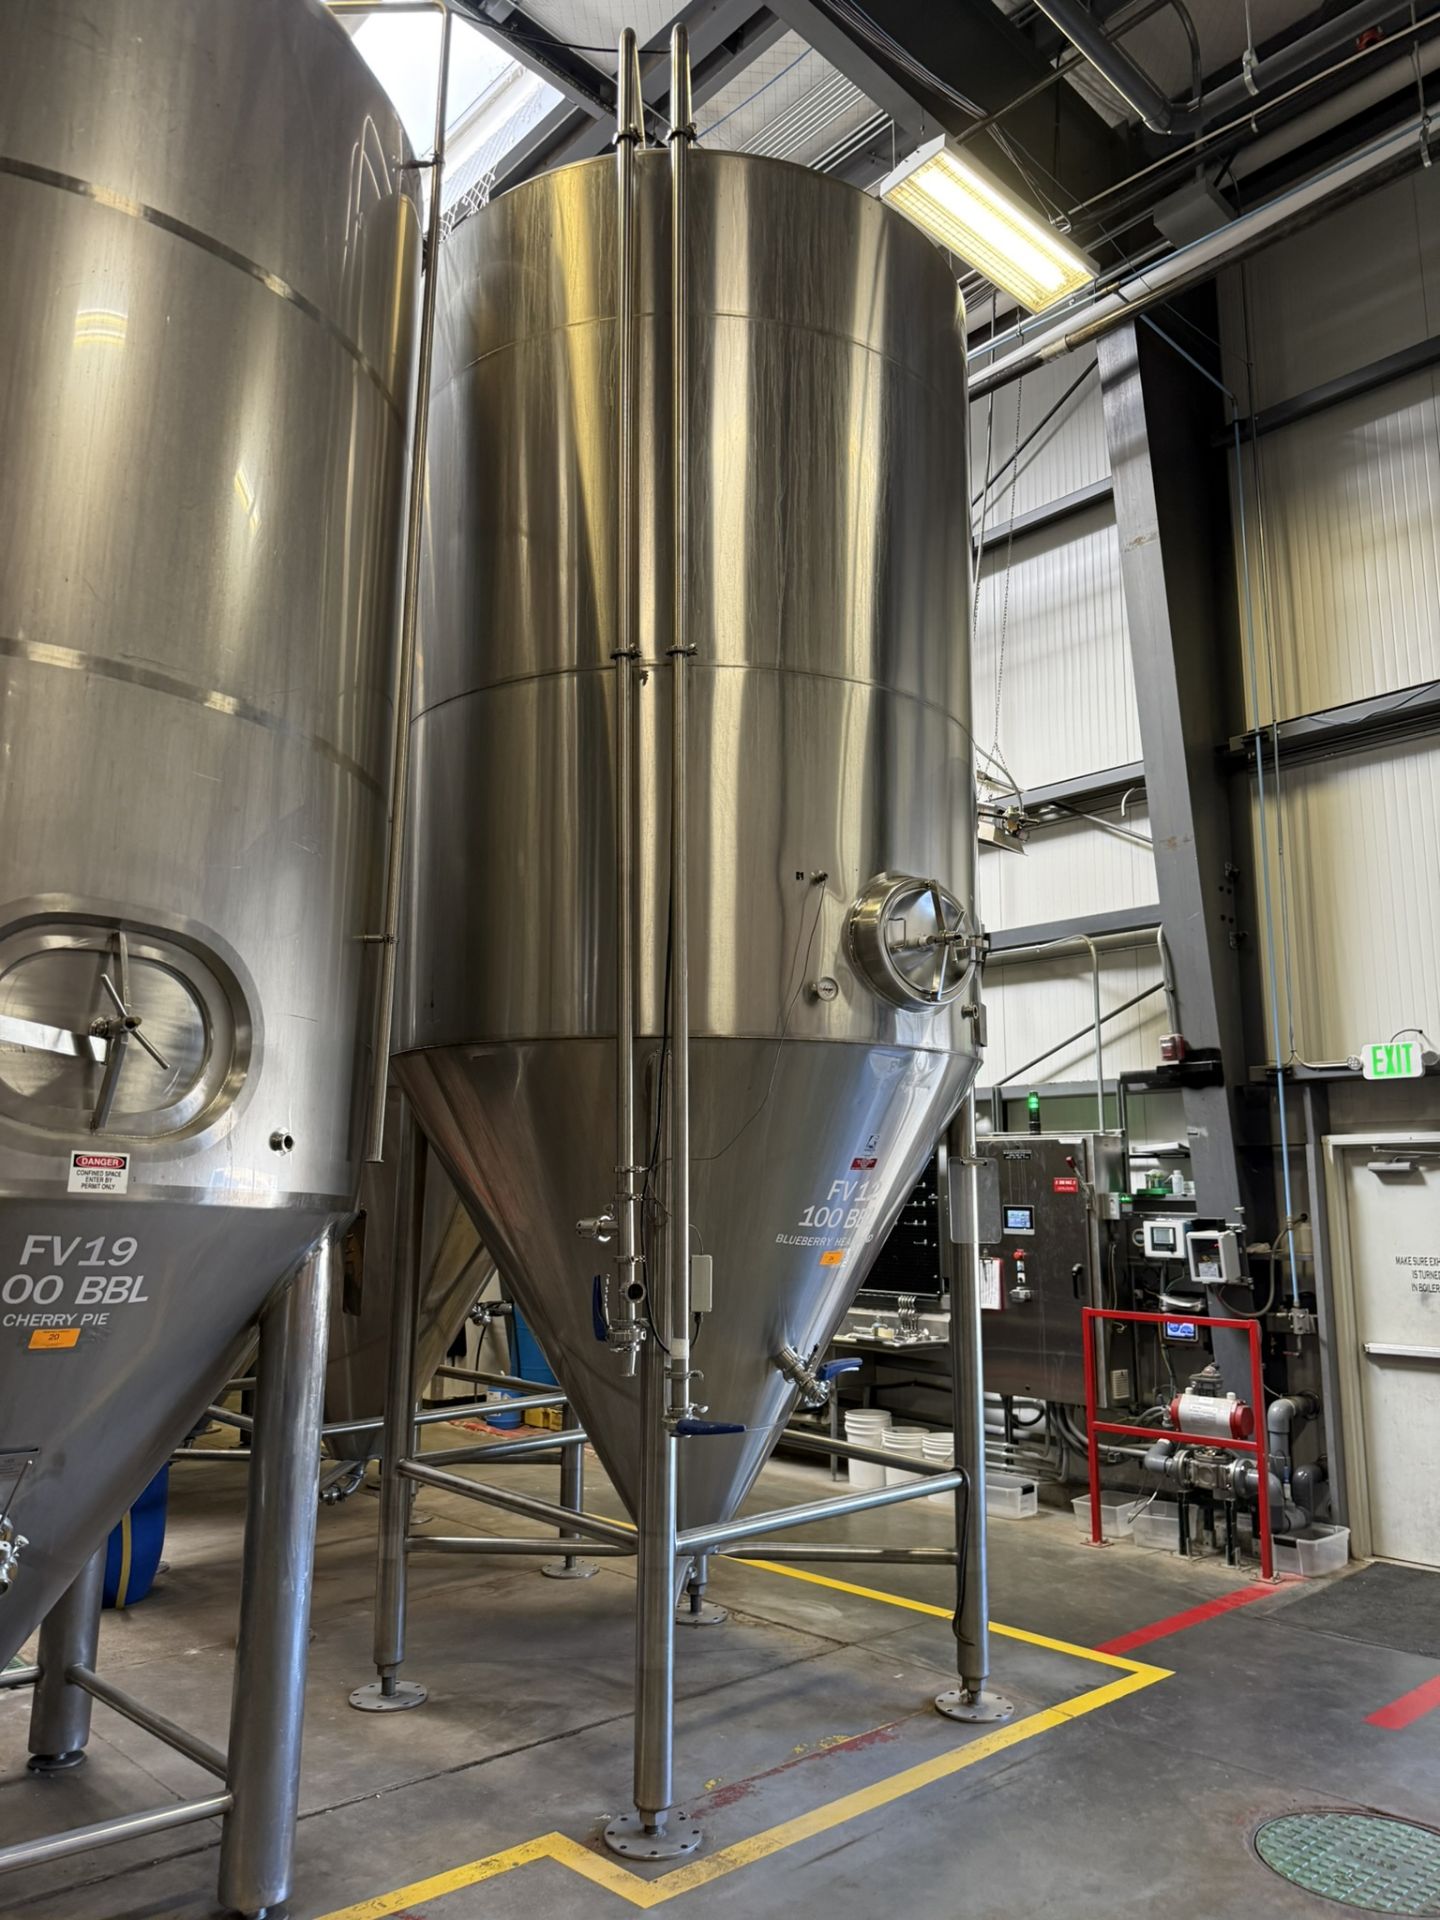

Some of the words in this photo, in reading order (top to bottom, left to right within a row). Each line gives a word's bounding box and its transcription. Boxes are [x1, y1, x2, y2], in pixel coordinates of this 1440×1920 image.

[1371, 1043, 1413, 1076] EXIT
[81, 1157, 119, 1166] DANGER
[798, 1205, 843, 1228] 100
[775, 1233, 833, 1247] BLUEBERRY
[19, 1235, 138, 1266] FV19
[1395, 1256, 1412, 1266] MAKE
[1413, 1256, 1429, 1267] SURE
[74, 1275, 149, 1304] BBL
[2, 1313, 77, 1327] CHERRY
[80, 1313, 110, 1326] PIE
